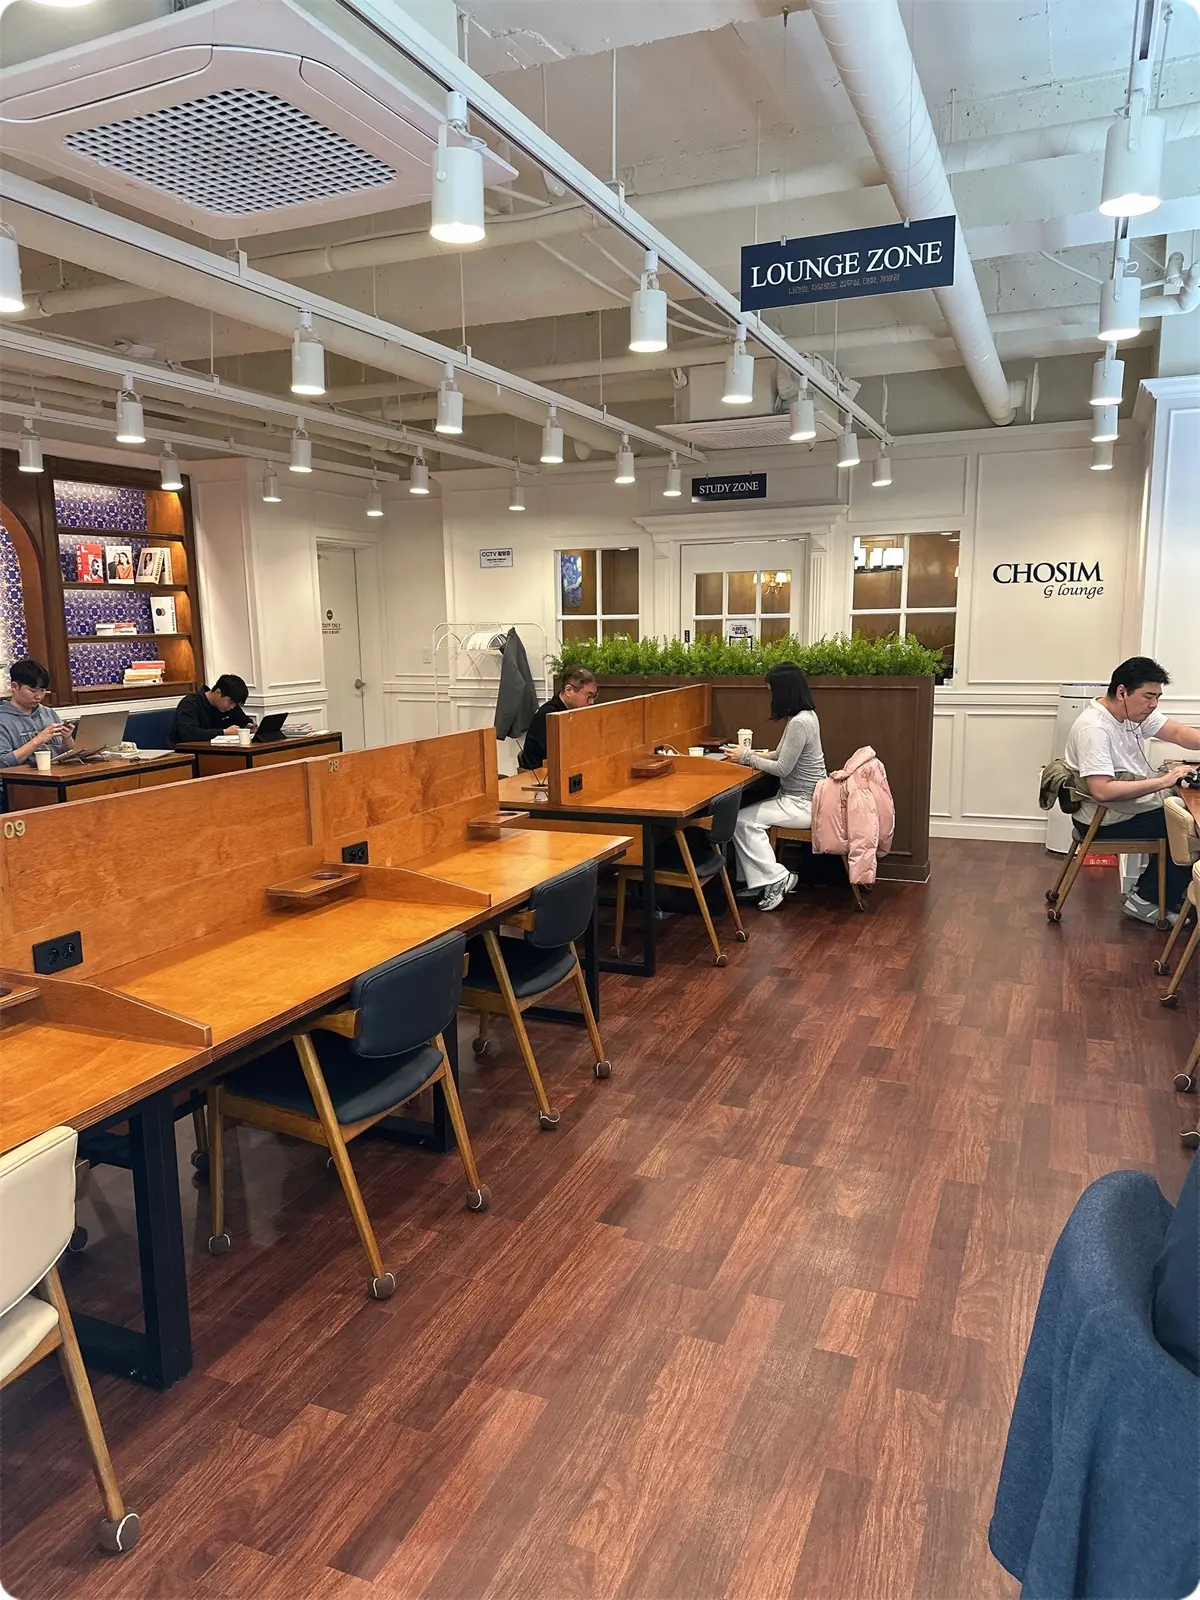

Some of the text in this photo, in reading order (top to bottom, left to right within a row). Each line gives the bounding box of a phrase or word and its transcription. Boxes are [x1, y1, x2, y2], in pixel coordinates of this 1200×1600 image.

[750, 240, 944, 288] LOUNGE ZONE
[699, 481, 760, 494] STUDY ZONE
[993, 561, 1104, 584] CHOSIM
[1043, 583, 1104, 600] G lounge
[328, 759, 341, 772] 08
[4, 819, 25, 838] 09
